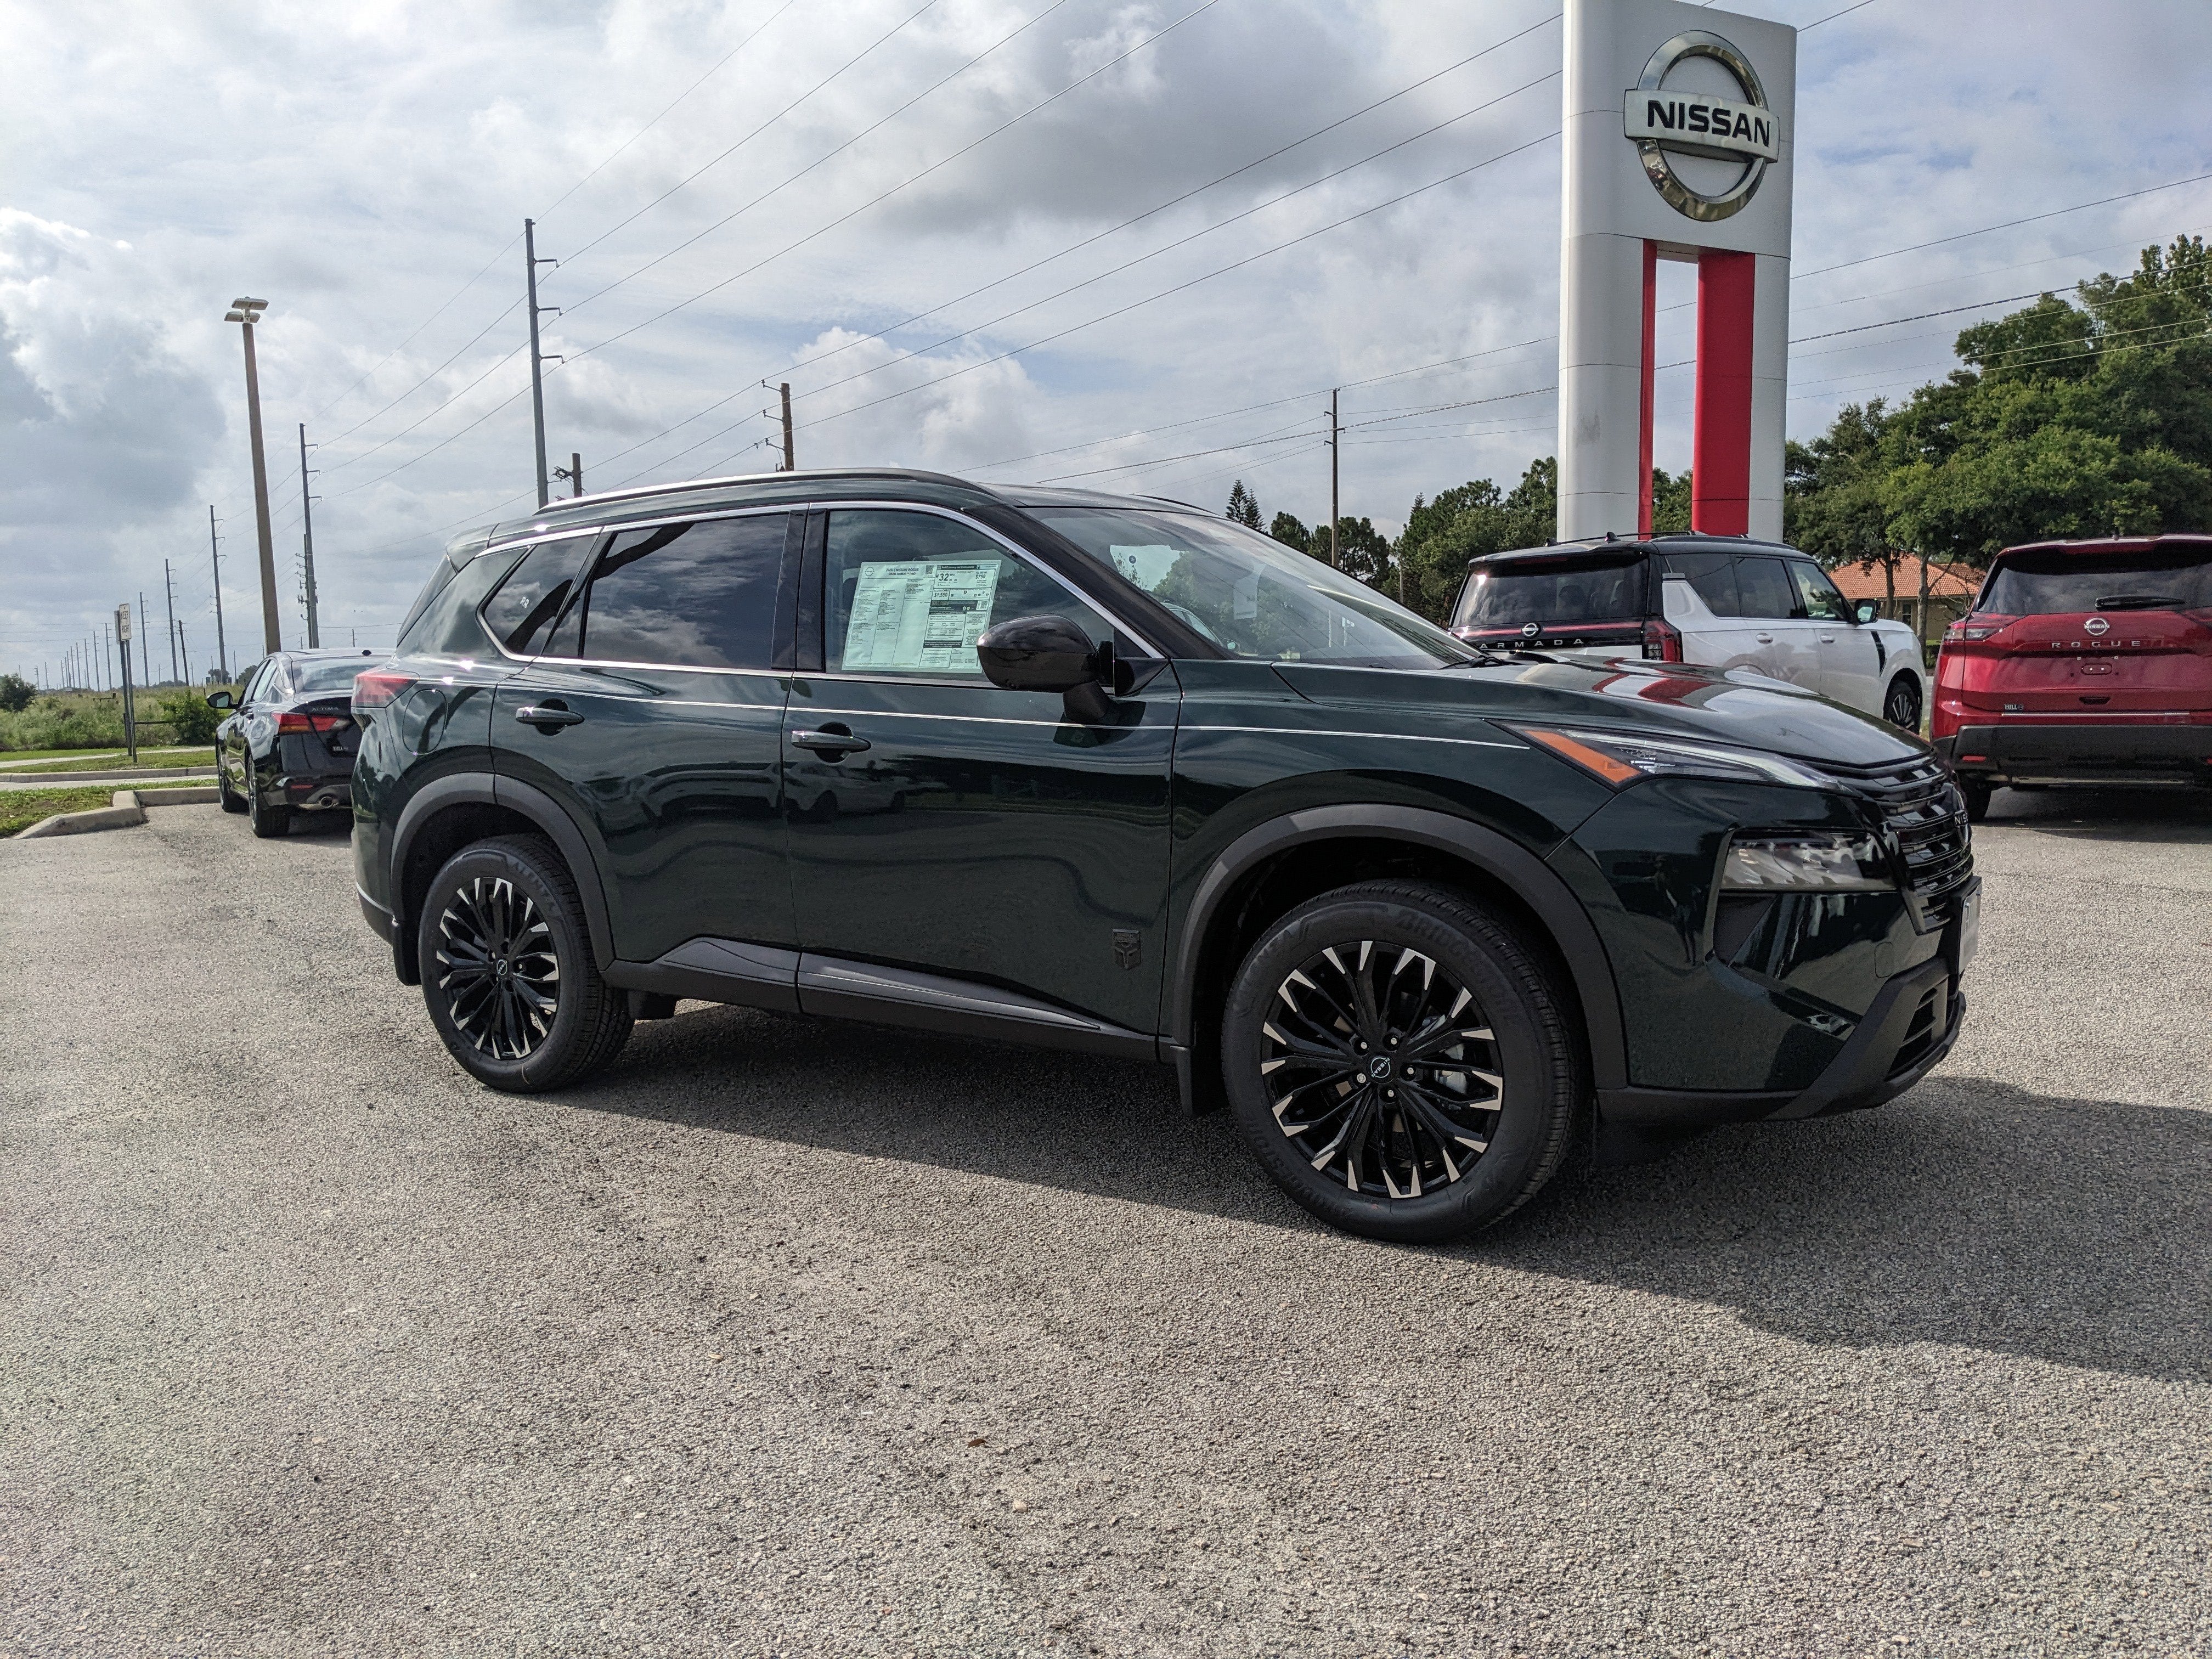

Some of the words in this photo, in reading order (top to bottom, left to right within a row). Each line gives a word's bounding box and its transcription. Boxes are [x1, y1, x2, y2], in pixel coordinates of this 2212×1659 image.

[1647, 100, 1770, 148] NISSAN
[1479, 639, 1584, 649] ARMADA
[1372, 1058, 1390, 1077] NISSAN
